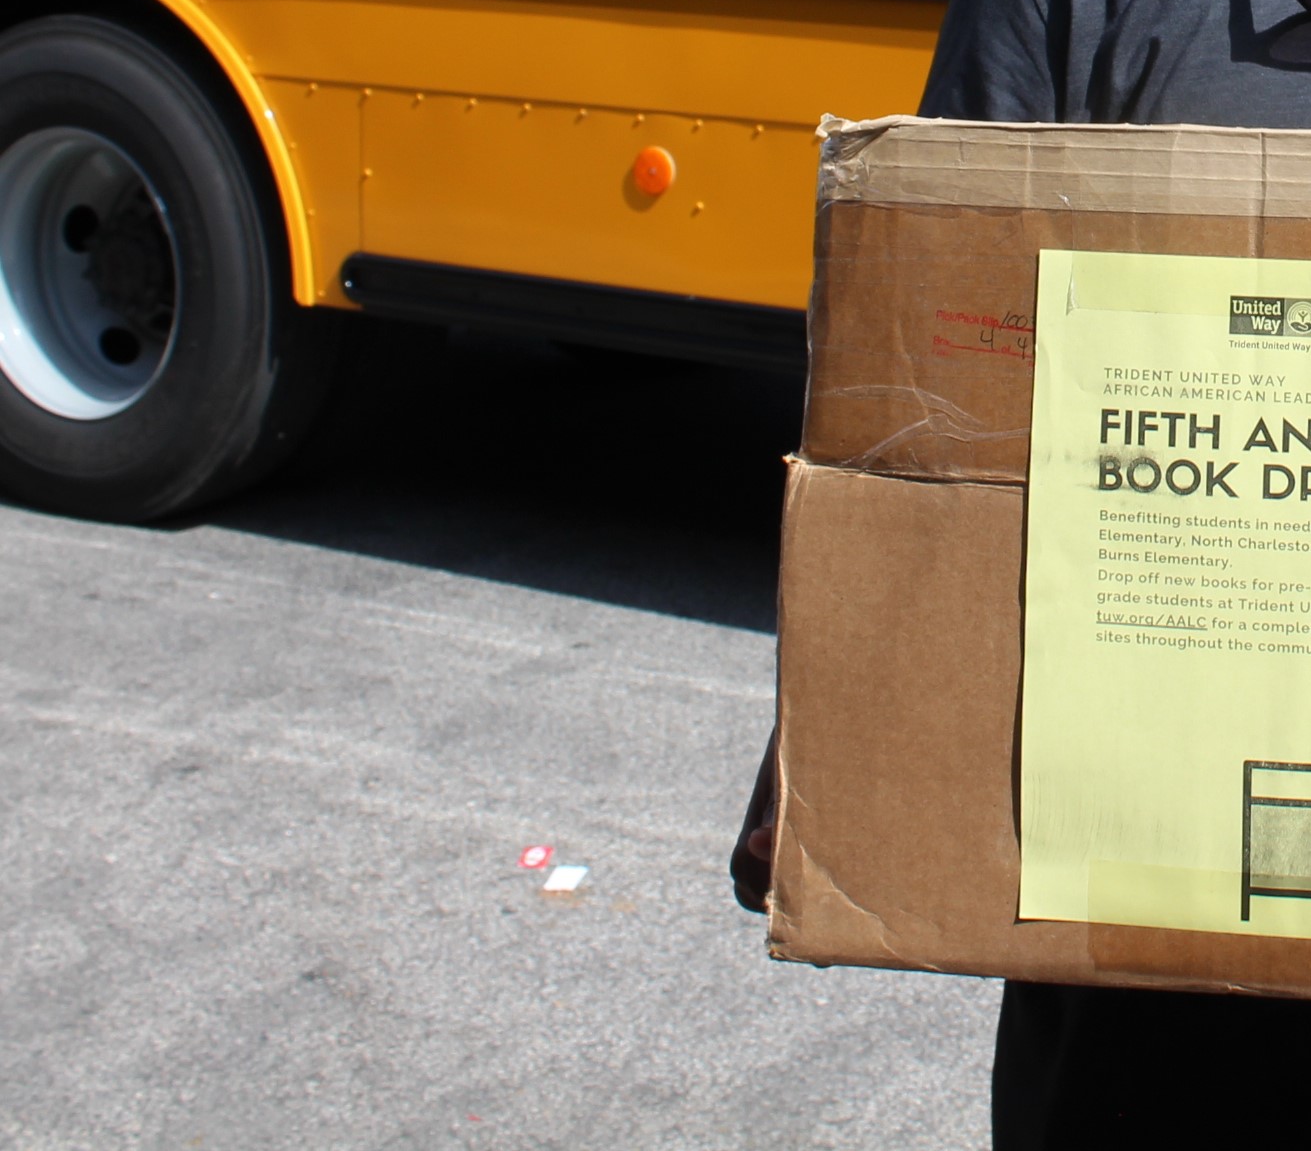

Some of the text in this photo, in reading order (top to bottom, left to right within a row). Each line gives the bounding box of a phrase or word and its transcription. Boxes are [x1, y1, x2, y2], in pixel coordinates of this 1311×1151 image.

[1232, 299, 1282, 316] United
[1251, 315, 1281, 335] Way
[1229, 340, 1310, 352] Trident United Way
[1104, 367, 1286, 388] TRIDENT UNITED WAY
[1103, 383, 1173, 398] AFRICAN
[1179, 387, 1267, 403] AMERICAN
[1099, 408, 1221, 450] FIFTH
[1099, 455, 1240, 498] BOOK
[1099, 509, 1181, 528] Benefitting
[1186, 516, 1250, 529] students
[1256, 519, 1268, 530] in
[1274, 521, 1310, 532] need
[1099, 528, 1186, 547] Elementary,
[1192, 535, 1232, 547] North
[1099, 549, 1233, 570] Burns Elementary.
[1098, 569, 1133, 585] Drop
[1139, 572, 1160, 584] off
[1165, 576, 1195, 586] new
[1201, 576, 1246, 589] books
[1253, 578, 1273, 590] for
[1097, 591, 1140, 604] grade
[1146, 594, 1212, 608] students
[1218, 598, 1232, 609] at
[1238, 598, 1294, 612] Trident
[1096, 610, 1208, 630] tuw.org/AALC
[1212, 617, 1233, 629] for
[1239, 622, 1246, 630] a
[1096, 630, 1130, 643] sites
[1136, 632, 1224, 650] throughout
[1228, 639, 1252, 650] the
